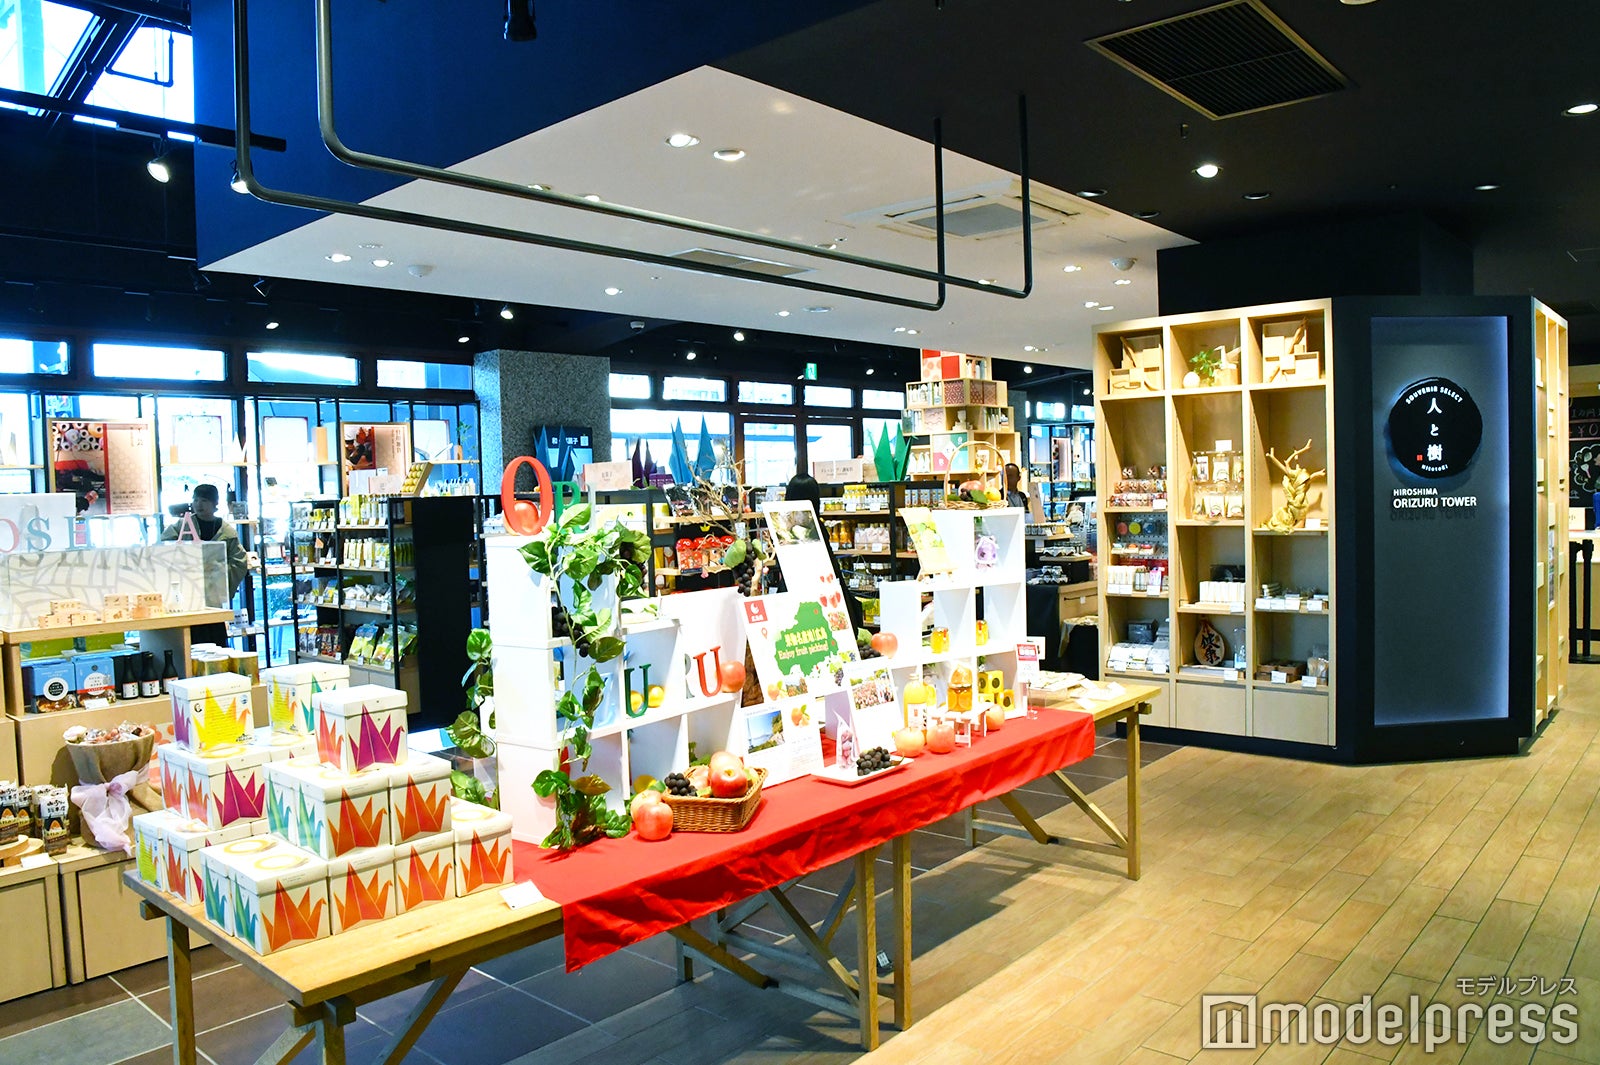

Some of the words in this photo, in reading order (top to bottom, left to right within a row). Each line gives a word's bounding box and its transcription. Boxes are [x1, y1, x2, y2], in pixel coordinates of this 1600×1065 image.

[1405, 386, 1438, 404] SOUVENIR
[1440, 386, 1463, 403] SELECT
[1427, 397, 1443, 461] 人と樹
[1393, 488, 1438, 496] HIROSHIMA
[1393, 497, 1438, 508] ORIZURU
[1441, 496, 1477, 507] TOWER
